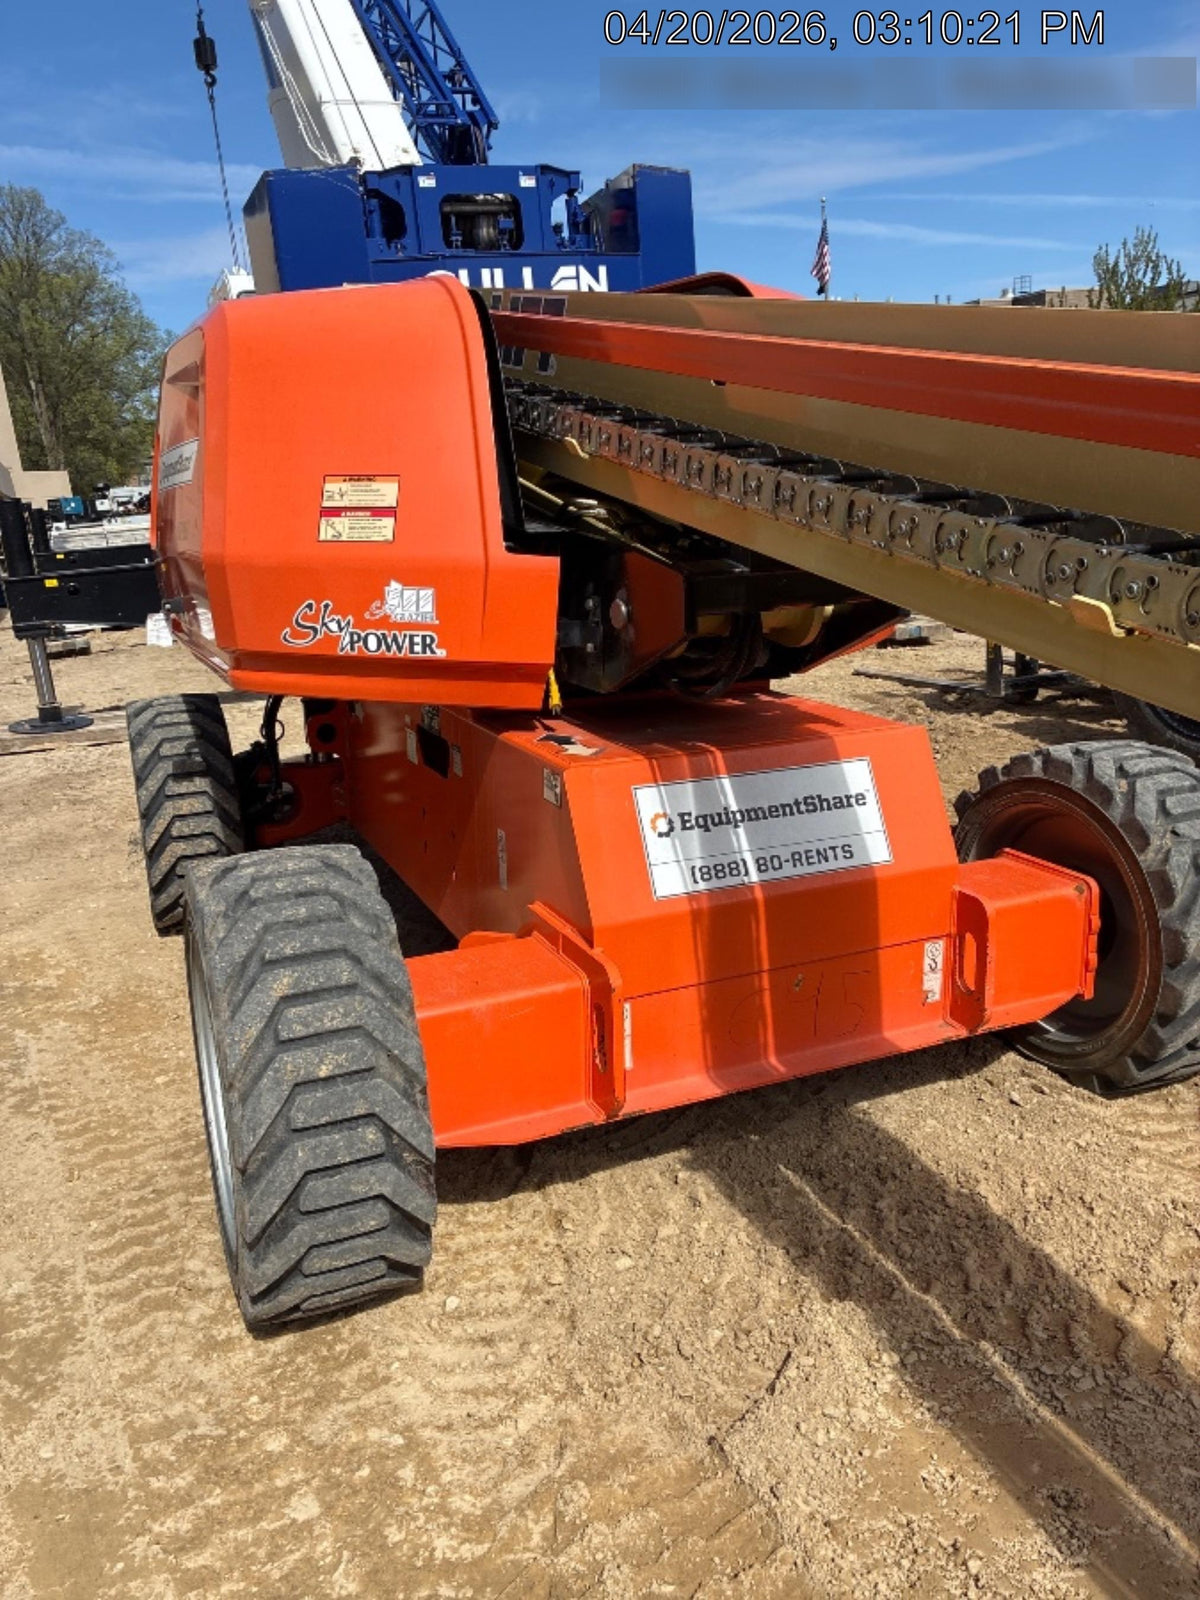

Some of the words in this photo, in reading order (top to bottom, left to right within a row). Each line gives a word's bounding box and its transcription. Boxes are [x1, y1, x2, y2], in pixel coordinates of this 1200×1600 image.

[281, 599, 353, 655] Sky
[346, 630, 438, 656] POWER
[677, 790, 868, 834] EquipmentShare
